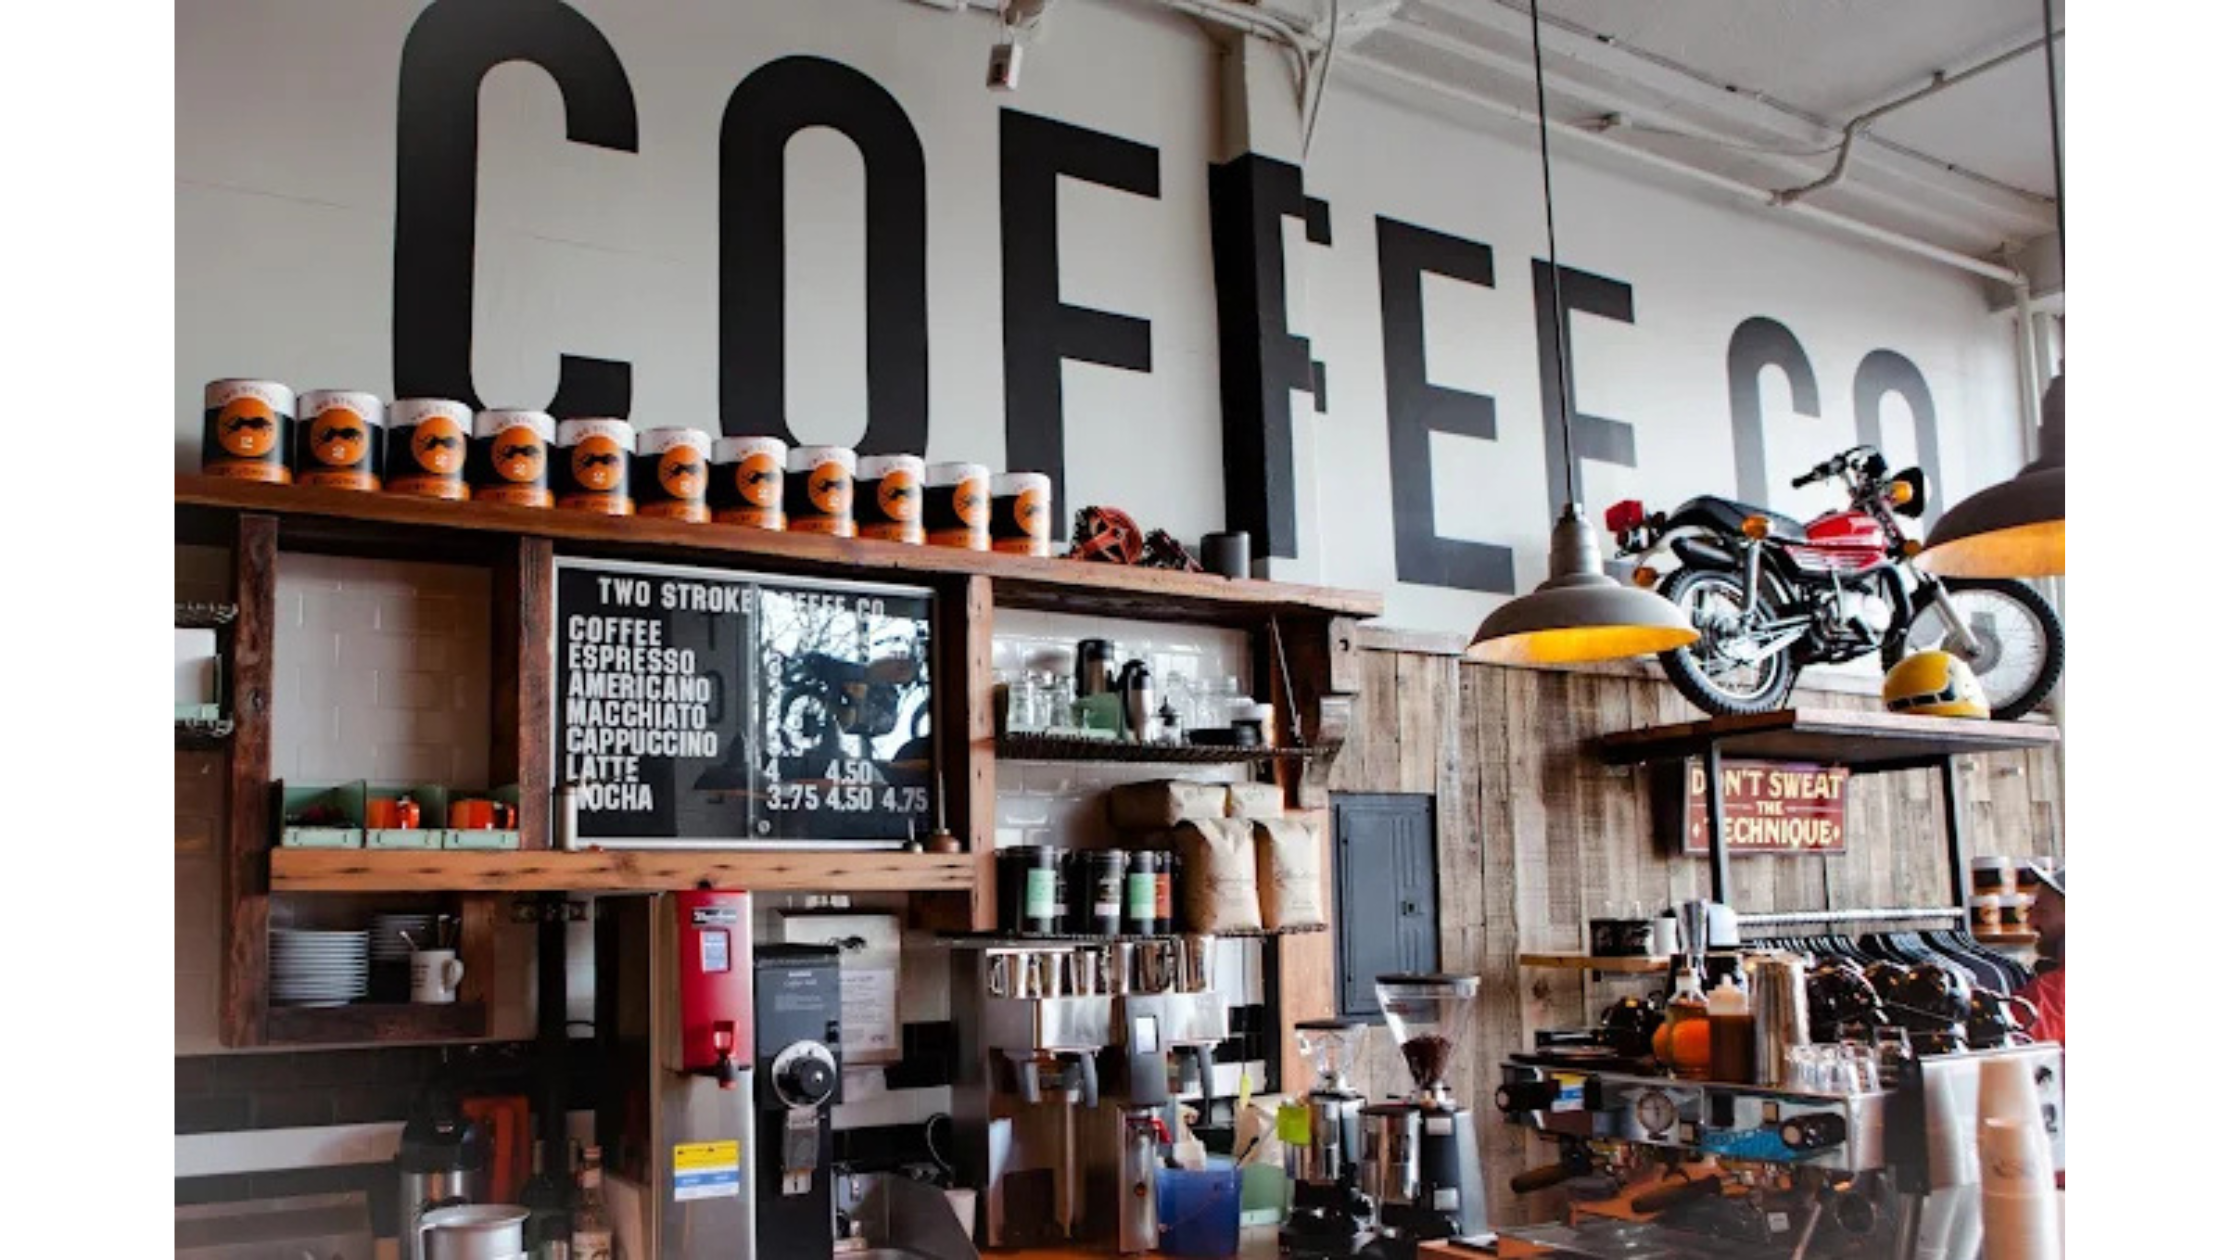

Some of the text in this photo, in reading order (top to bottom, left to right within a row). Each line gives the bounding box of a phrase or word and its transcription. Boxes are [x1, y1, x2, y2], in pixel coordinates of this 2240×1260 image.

[393, 0, 1640, 595] COFFEE
[597, 576, 650, 607] TWO
[661, 582, 753, 613] STROKE
[568, 614, 662, 647] COFFEE
[568, 643, 696, 676] ESPRESSO
[568, 670, 711, 703] AMERICANO
[566, 698, 707, 730] MACCHIATO
[566, 726, 718, 758] CAPPUCCINO
[566, 753, 874, 786] LATTE 4 4.50
[1691, 768, 1842, 799] DN'T SWEAT
[766, 784, 819, 811] 3.75
[825, 785, 873, 812] 4.50
[882, 786, 928, 813] 4.75
[1756, 801, 1784, 816] THE
[1704, 816, 1832, 847] ECHNIQUE
